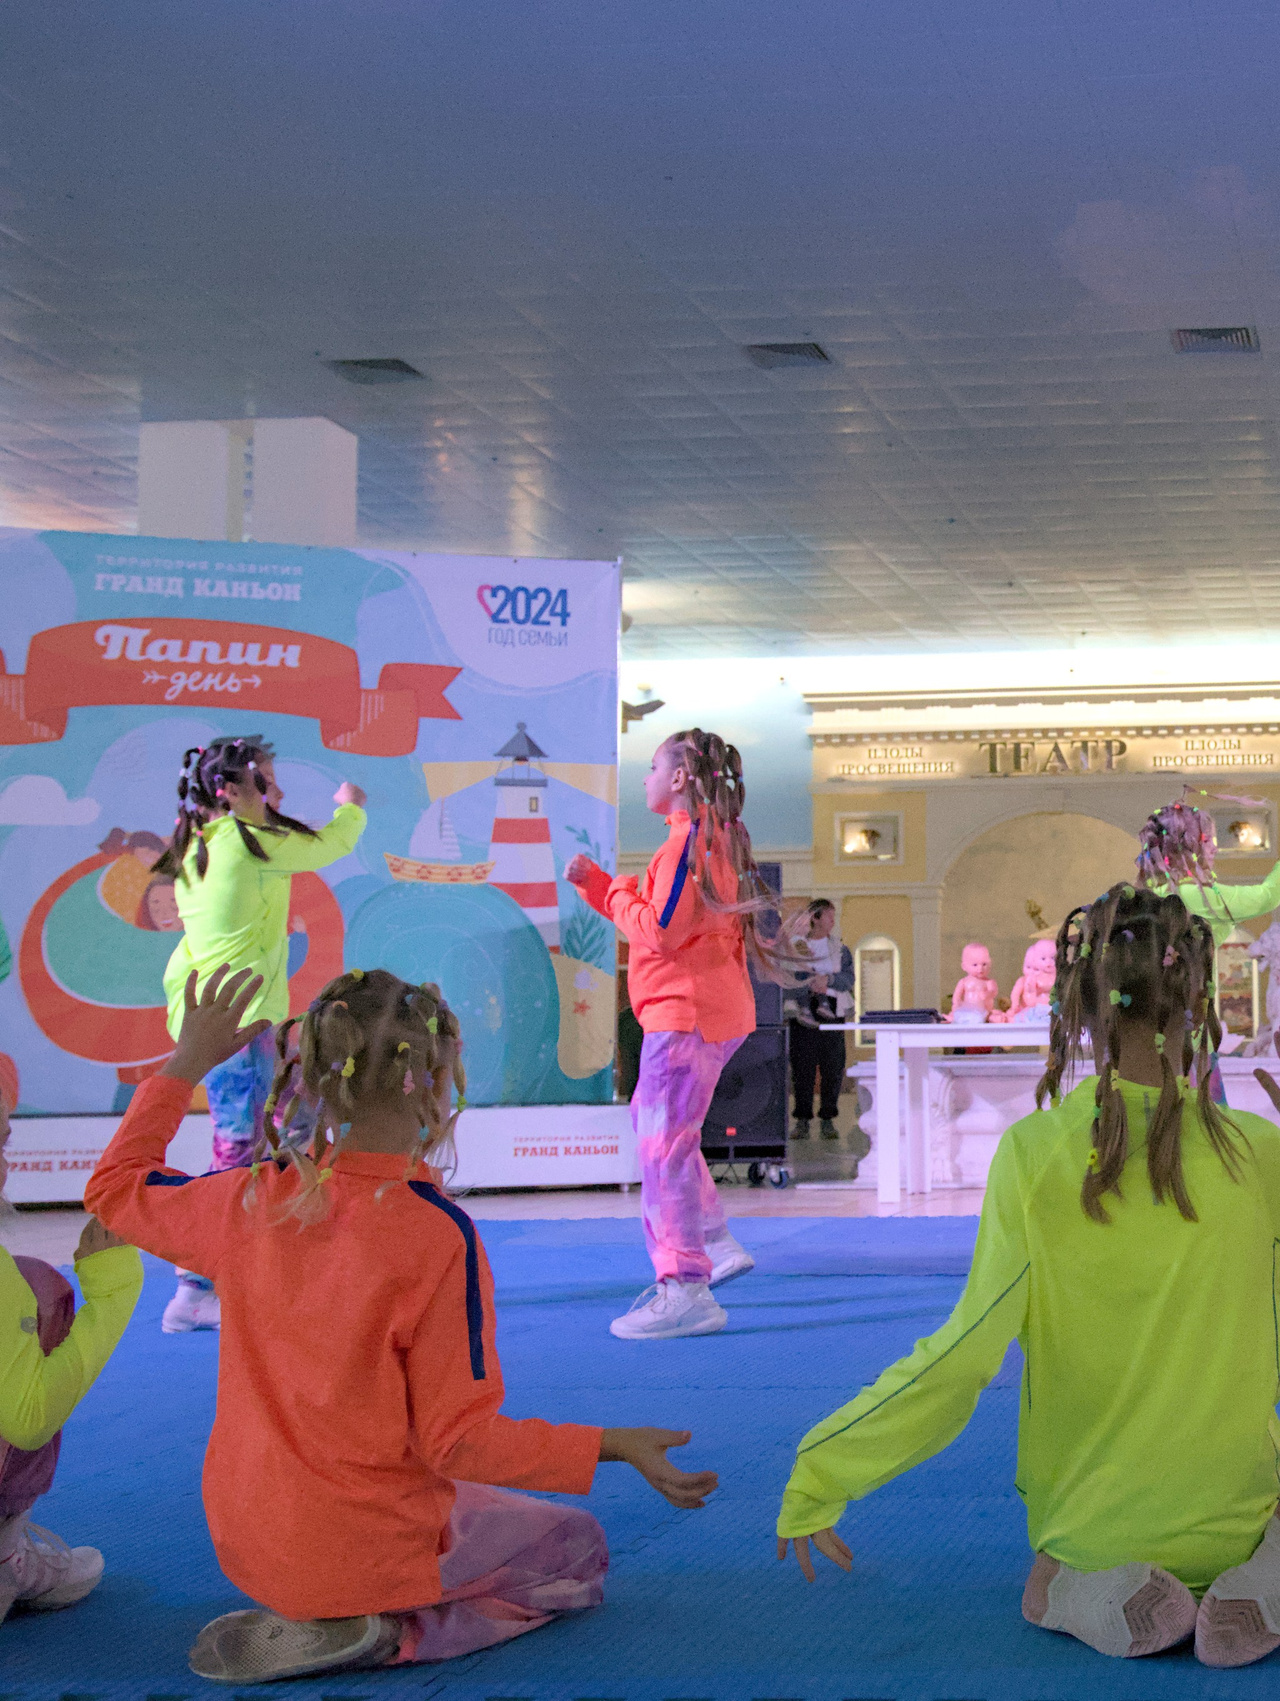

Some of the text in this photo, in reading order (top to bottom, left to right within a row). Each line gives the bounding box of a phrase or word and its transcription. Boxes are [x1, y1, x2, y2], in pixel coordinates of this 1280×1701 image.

[95, 553, 303, 576] ТЕРРИТОРИЯ РАЗВИТИЯ
[94, 572, 301, 601] ГРАНД КАНЬОН
[490, 584, 571, 627] 2024
[94, 624, 301, 668] Папин
[488, 627, 516, 648] ГОД
[164, 670, 242, 701] день
[867, 747, 923, 760] ПЛОДЫ
[979, 738, 1128, 774] ТЕАТР
[1185, 739, 1242, 752] ПЛОДЫ
[837, 761, 955, 775] ПРОСВЕЩЕНИЯ
[1152, 753, 1275, 768] ПРОСВЕЩЕНИЯ
[513, 1144, 619, 1158] ГРАНД КАНЬОН
[8, 1160, 52, 1173] РАНД
